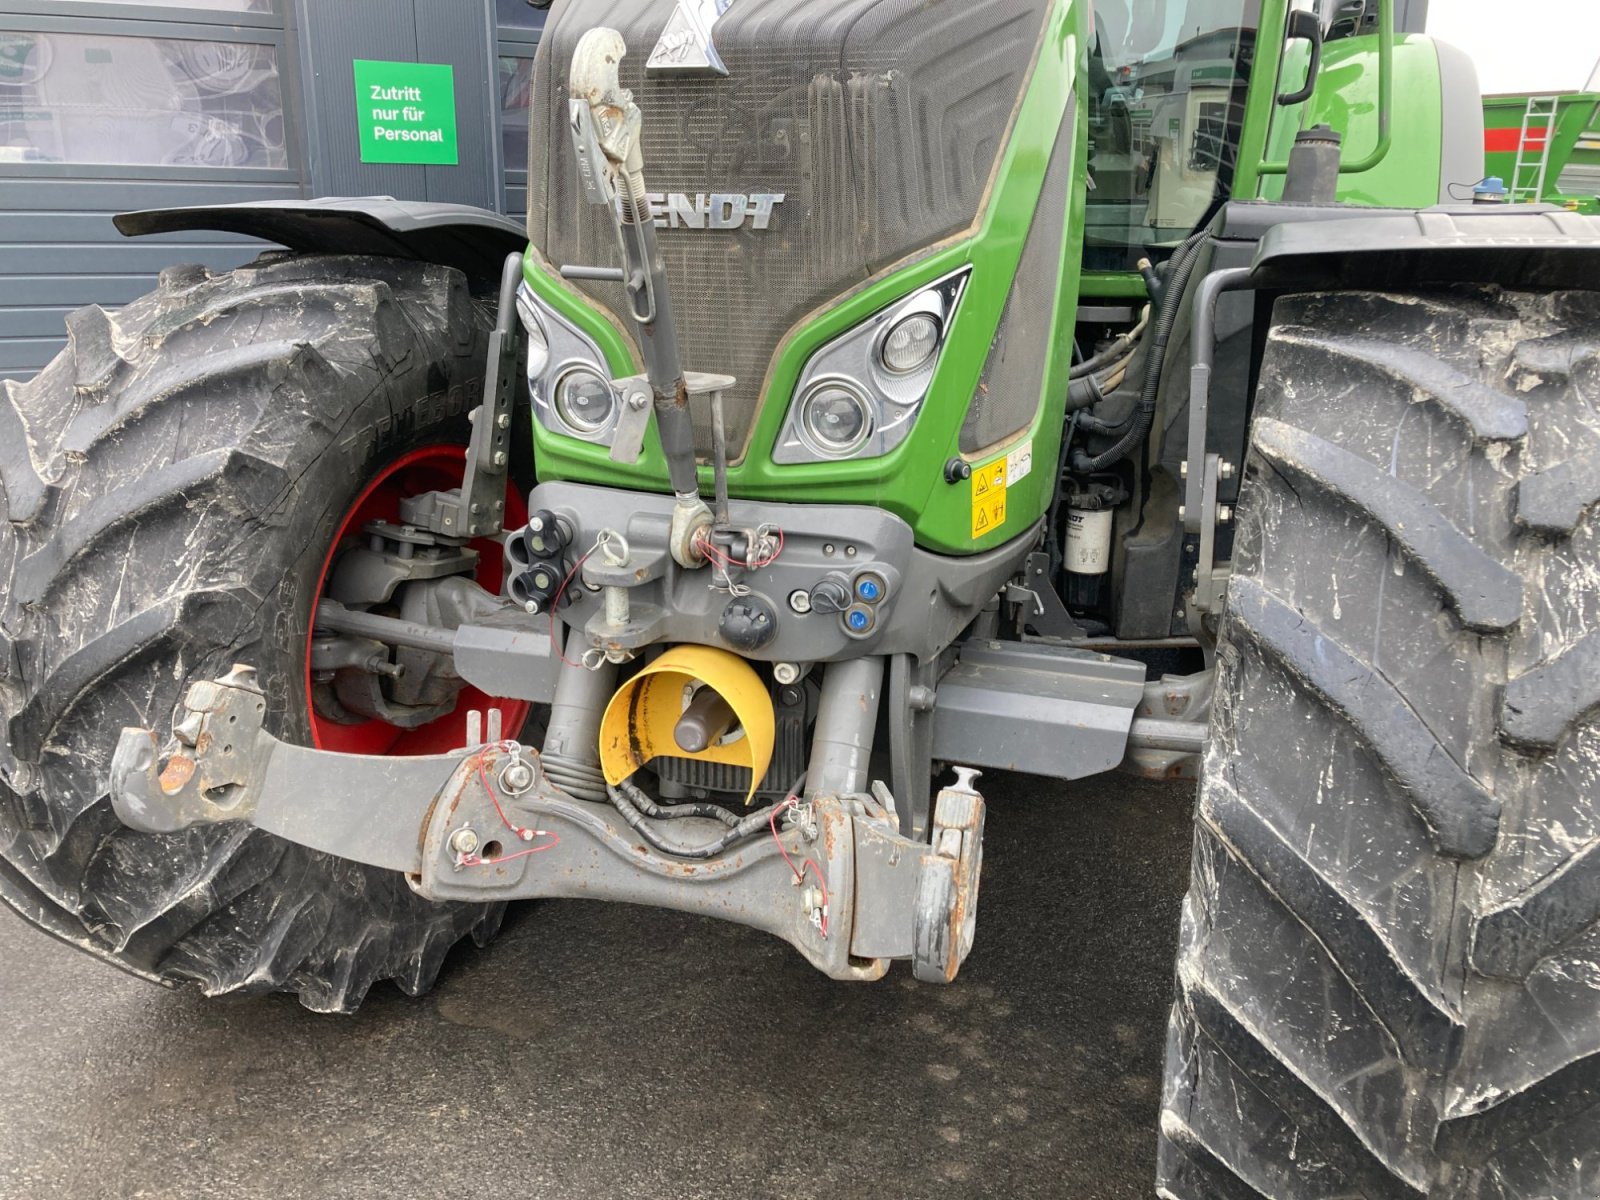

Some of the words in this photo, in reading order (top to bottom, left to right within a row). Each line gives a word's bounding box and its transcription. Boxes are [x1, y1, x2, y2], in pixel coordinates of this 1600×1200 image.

[370, 85, 421, 101] Zutritt
[372, 108, 399, 120] nur
[402, 106, 425, 121] für
[374, 126, 443, 142] Personal
[617, 192, 786, 230] ENDT
